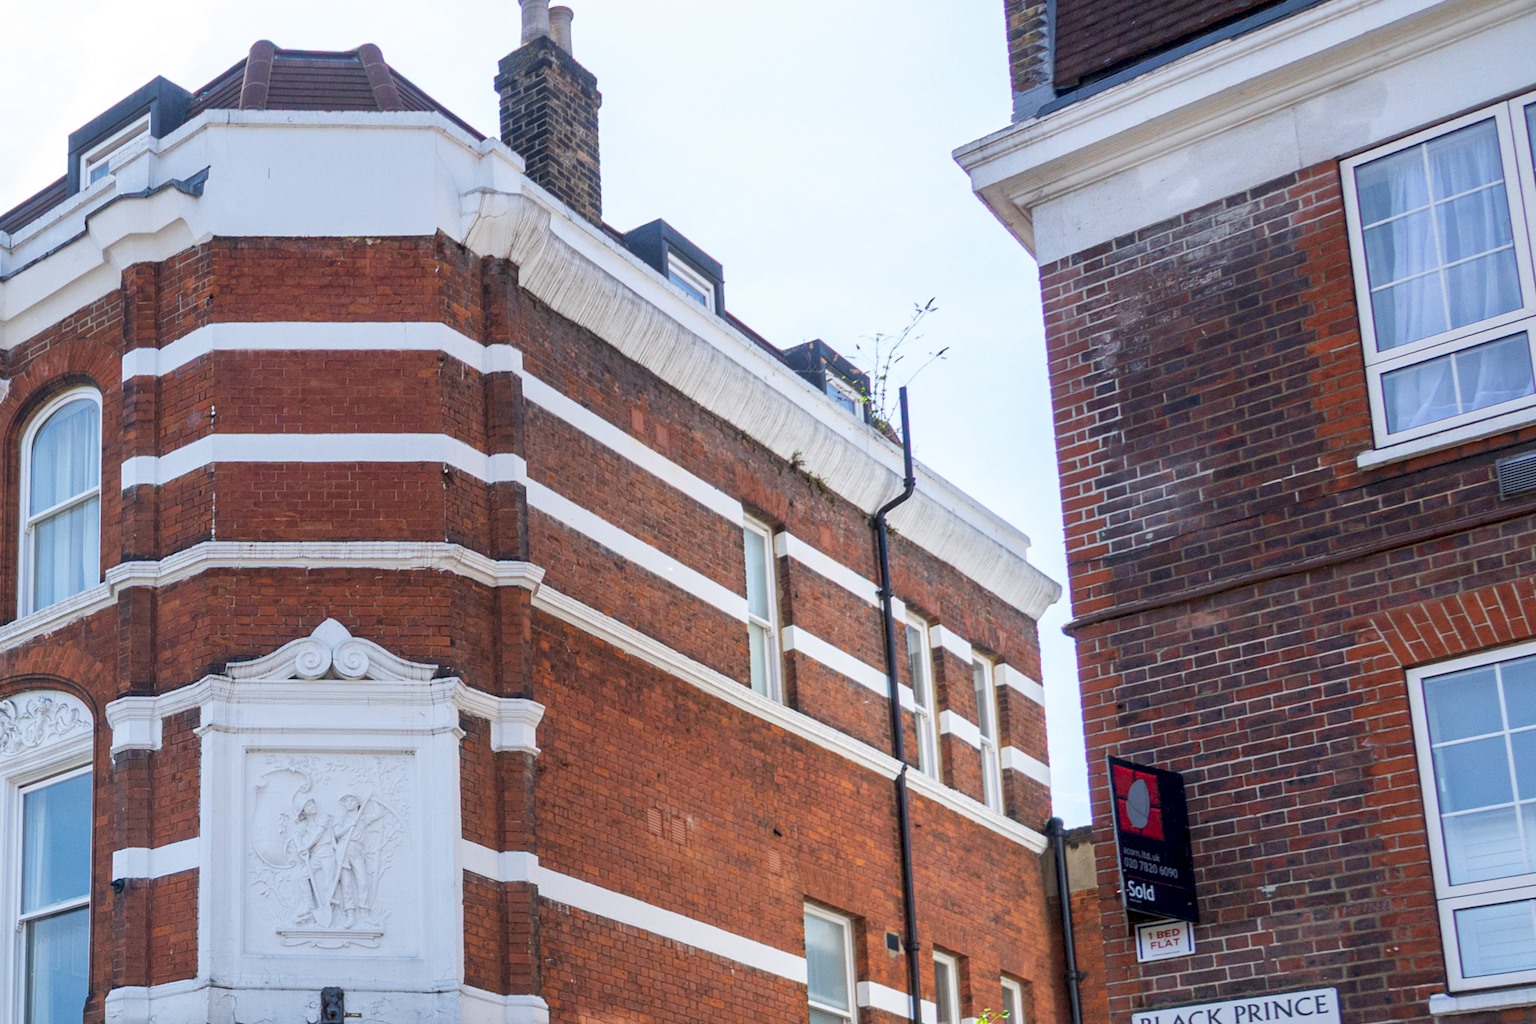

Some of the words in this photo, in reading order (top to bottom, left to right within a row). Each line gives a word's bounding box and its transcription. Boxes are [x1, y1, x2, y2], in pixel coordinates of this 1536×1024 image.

[1124, 857, 1138, 870] 020
[1139, 861, 1158, 875] 7820
[1159, 866, 1179, 878] 6090
[1127, 880, 1155, 901] Sold
[1150, 938, 1181, 950] FLAT
[1156, 928, 1181, 939] BED
[1234, 994, 1329, 1024] PRINCE
